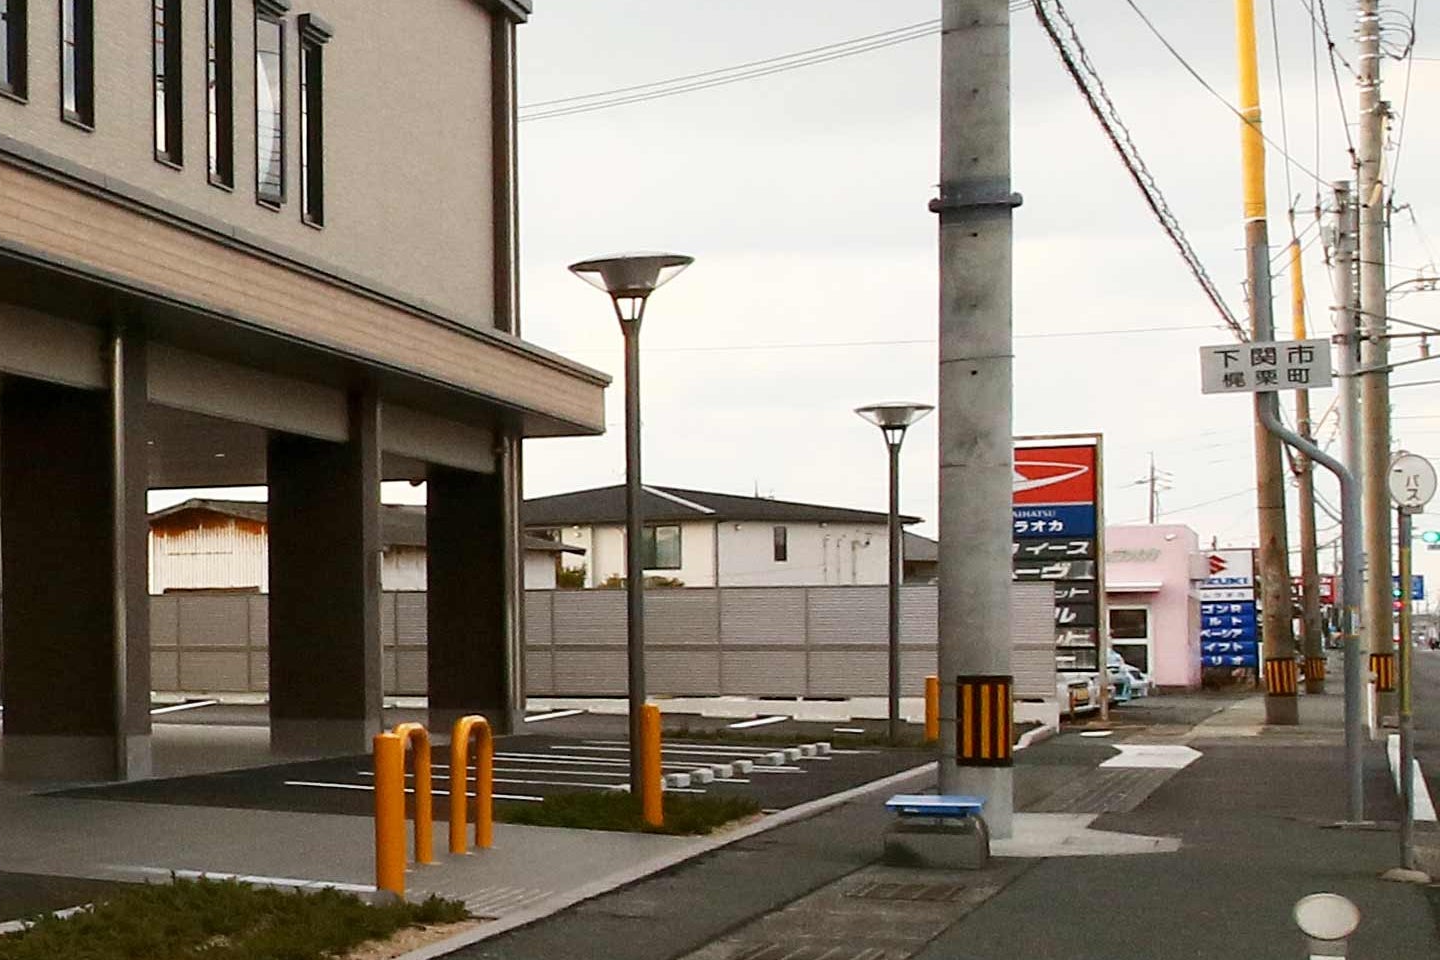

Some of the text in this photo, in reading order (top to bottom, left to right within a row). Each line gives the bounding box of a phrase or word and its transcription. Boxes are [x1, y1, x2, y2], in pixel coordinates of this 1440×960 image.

[1213, 345, 1315, 369] 下関市
[1222, 368, 1310, 388] 梶栗町
[1406, 474, 1421, 501] バス
[1203, 577, 1248, 585] ZUKI
